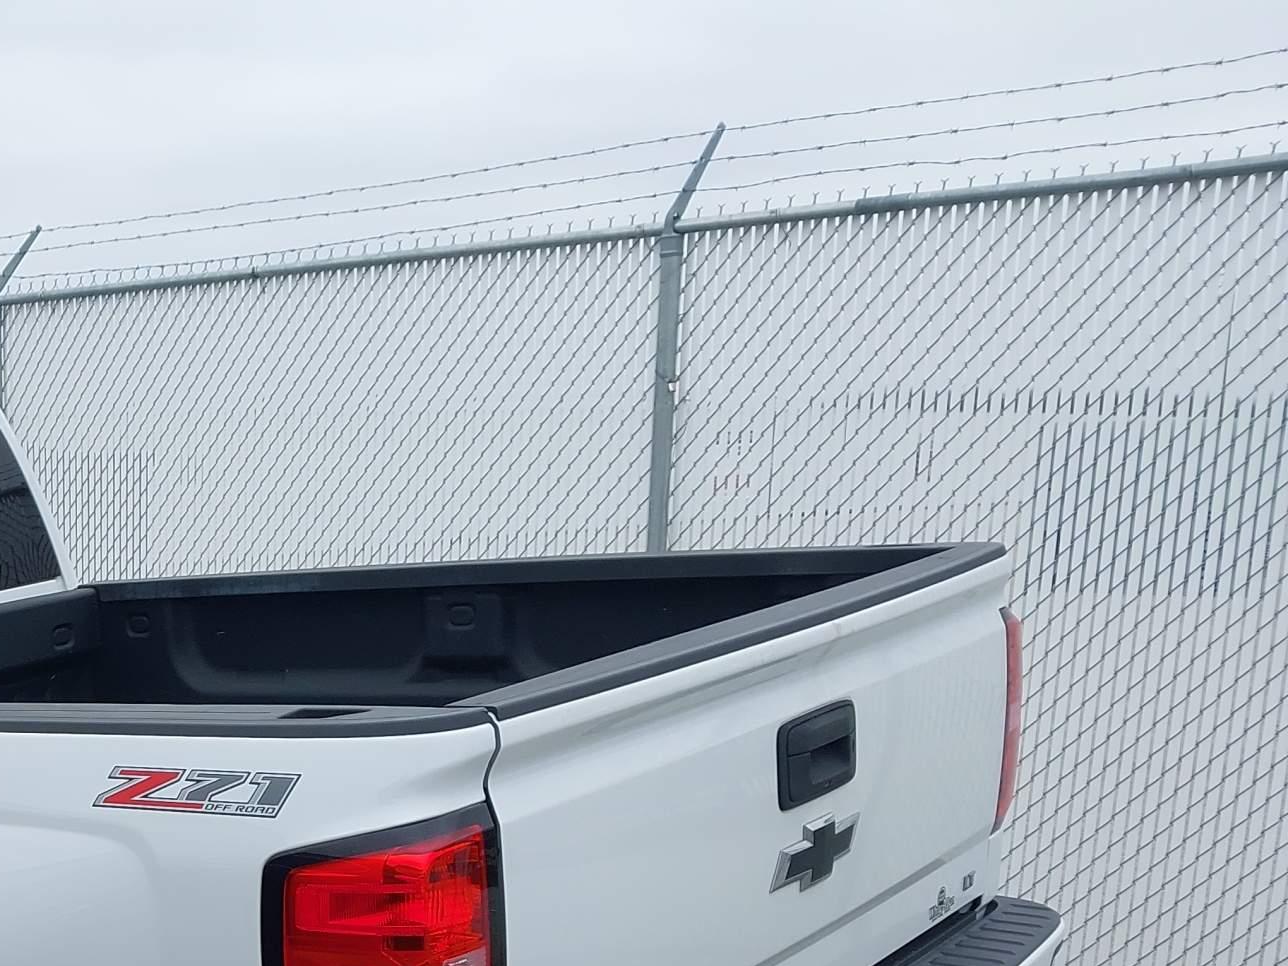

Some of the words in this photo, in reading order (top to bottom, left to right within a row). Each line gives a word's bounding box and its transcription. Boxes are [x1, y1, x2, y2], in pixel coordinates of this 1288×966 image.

[92, 765, 302, 818] Z71
[205, 803, 234, 813] OFF
[235, 804, 276, 815] ROAD
